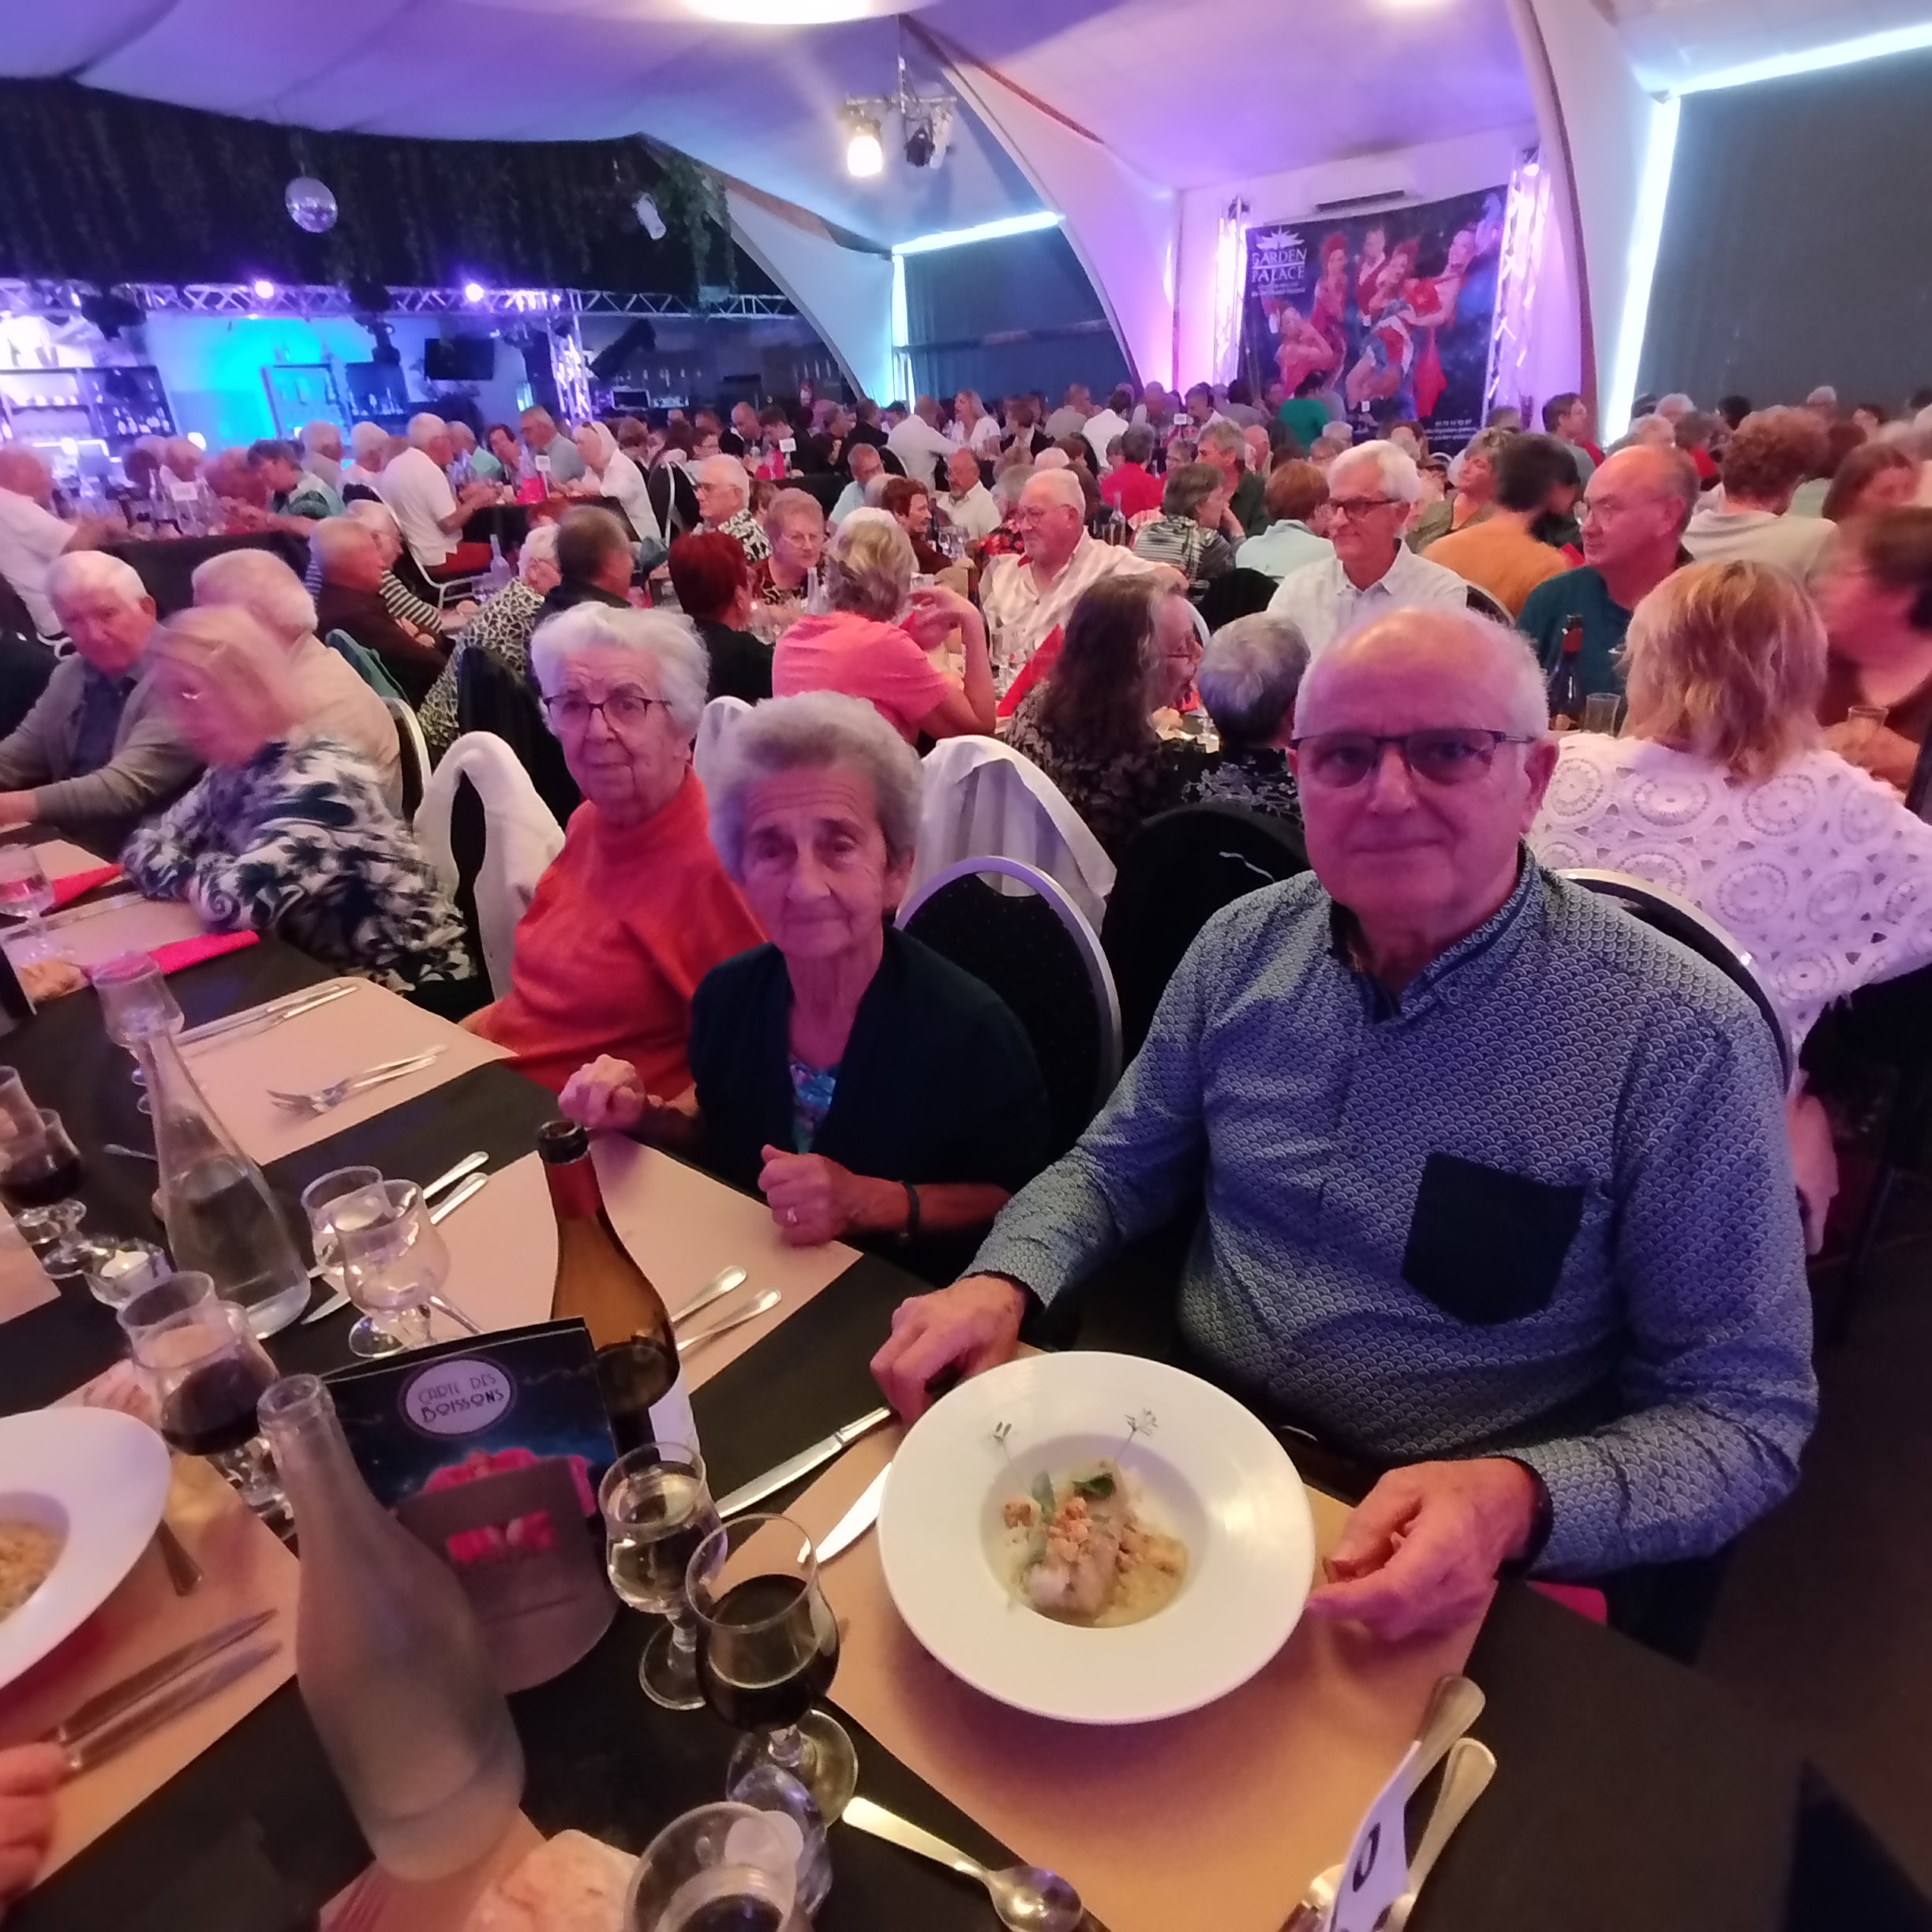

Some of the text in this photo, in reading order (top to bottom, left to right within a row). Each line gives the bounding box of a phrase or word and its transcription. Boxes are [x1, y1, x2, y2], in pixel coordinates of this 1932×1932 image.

[1251, 248, 1307, 266] GARDEN
[1252, 265, 1305, 283] PALACE
[418, 1374, 496, 1405] CARTE DES
[421, 1389, 504, 1423] BOISSONS
